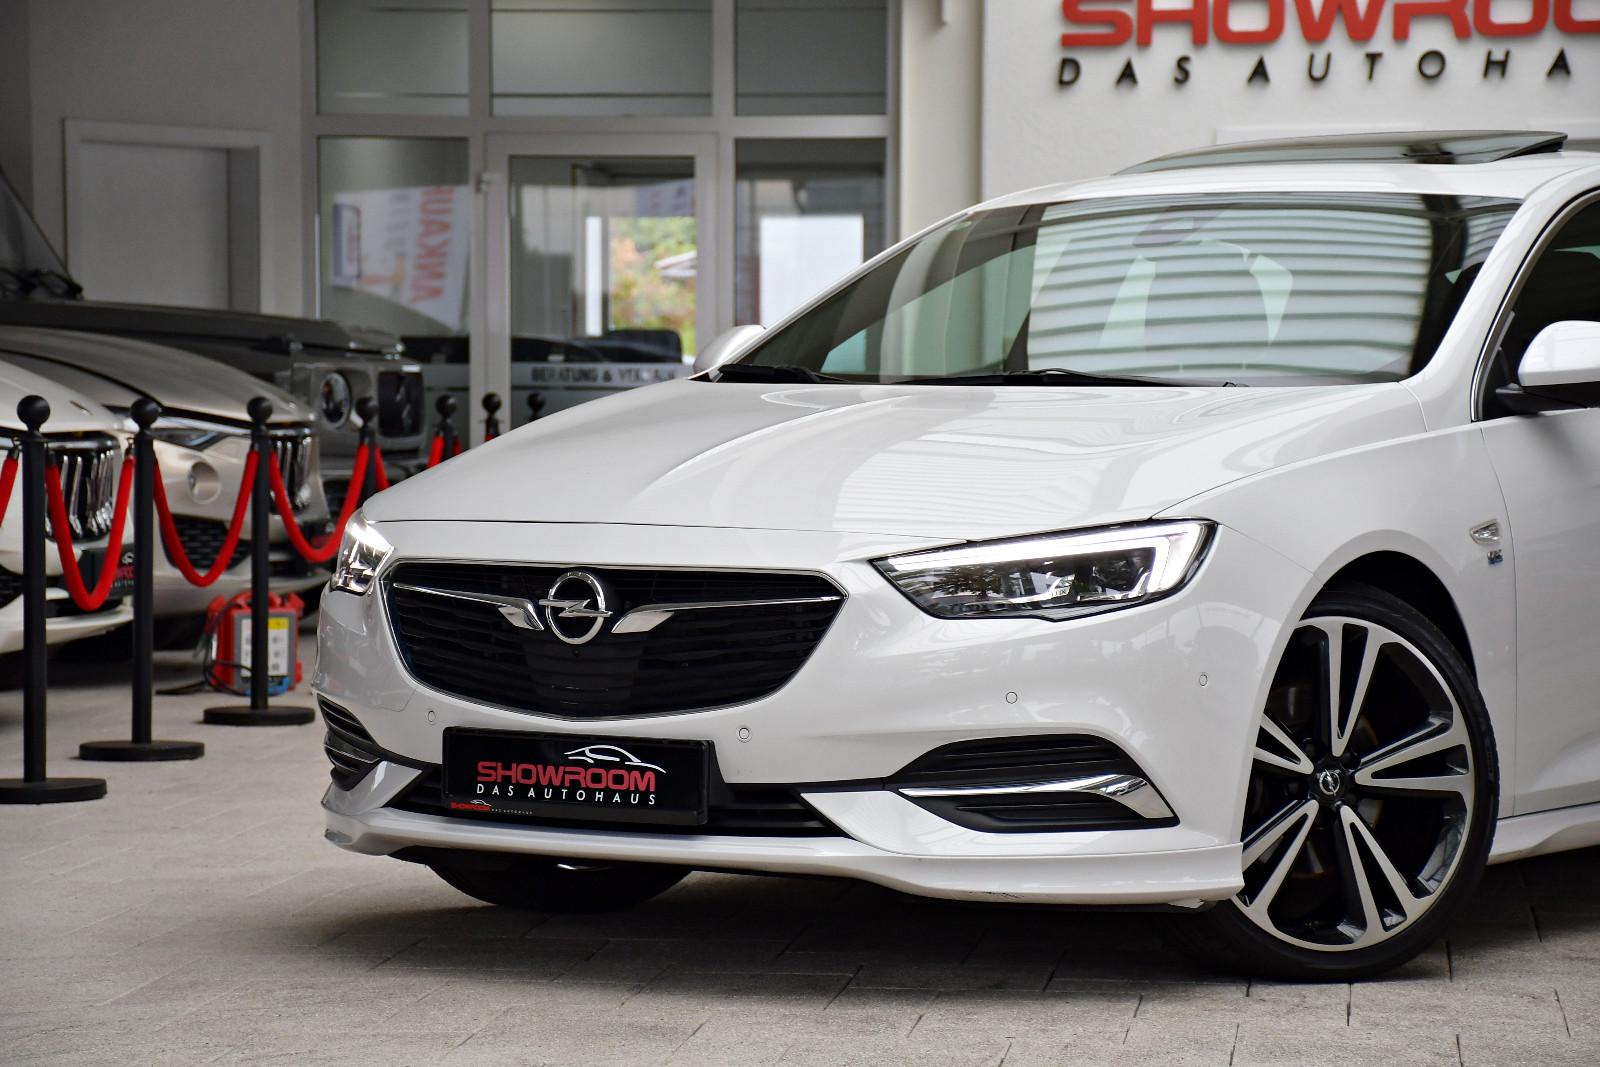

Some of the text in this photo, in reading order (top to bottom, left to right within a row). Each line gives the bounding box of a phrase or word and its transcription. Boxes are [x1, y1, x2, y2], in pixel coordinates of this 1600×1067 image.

[1057, 48, 1573, 86] DAS AUTOHA
[476, 761, 656, 792] SHOWROOM
[476, 784, 656, 805] DAS AUTOHAUS
